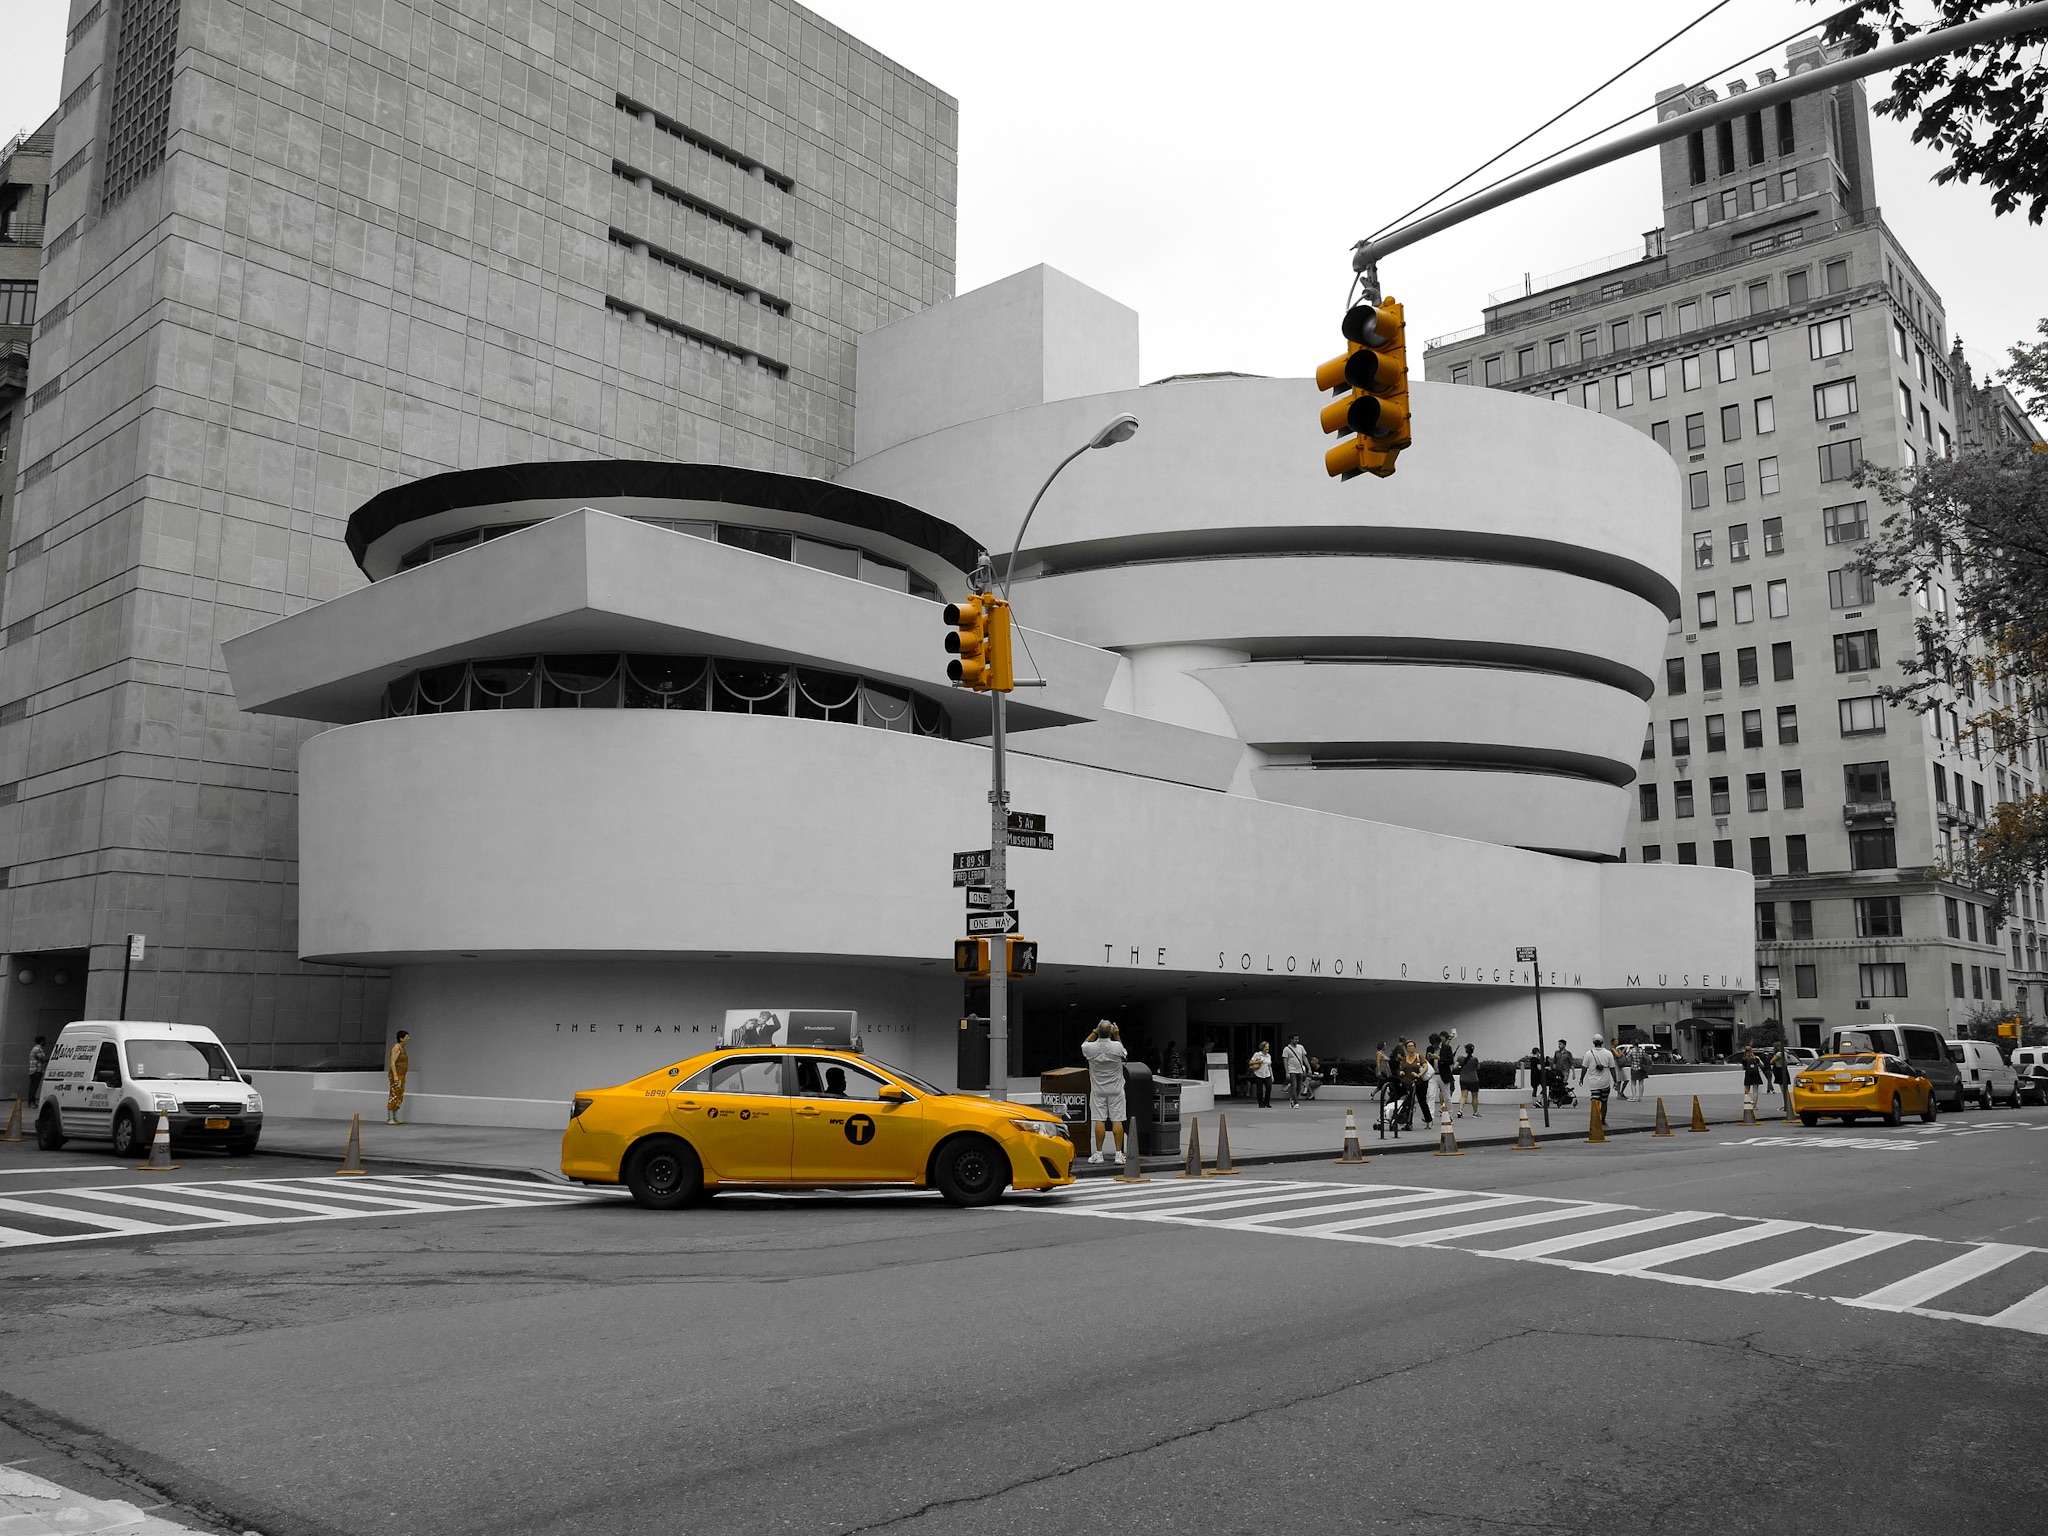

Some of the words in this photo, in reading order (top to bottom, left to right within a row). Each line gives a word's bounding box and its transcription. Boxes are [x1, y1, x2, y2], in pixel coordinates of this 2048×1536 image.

[1018, 815, 1023, 828] 5
[1025, 817, 1034, 829] Av
[1007, 833, 1036, 847] Museum
[1038, 835, 1053, 849] Mile
[960, 857, 964, 868] E
[966, 856, 975, 867] 89
[977, 855, 985, 867] St
[953, 871, 967, 881] FRED
[973, 893, 988, 903] ONE
[973, 919, 988, 929] ONE
[995, 917, 1011, 928] WAY
[1104, 943, 1167, 966] THE
[1218, 951, 1364, 976] SOLOMON
[1401, 962, 1408, 978] R
[1442, 965, 1582, 986] GUGGENHEIM
[1626, 974, 1743, 988] MUSEUM
[555, 1023, 597, 1033] THE
[1043, 1095, 1060, 1105] VOICE
[1064, 1095, 1085, 1105] VOICE
[851, 1119, 870, 1141] T
